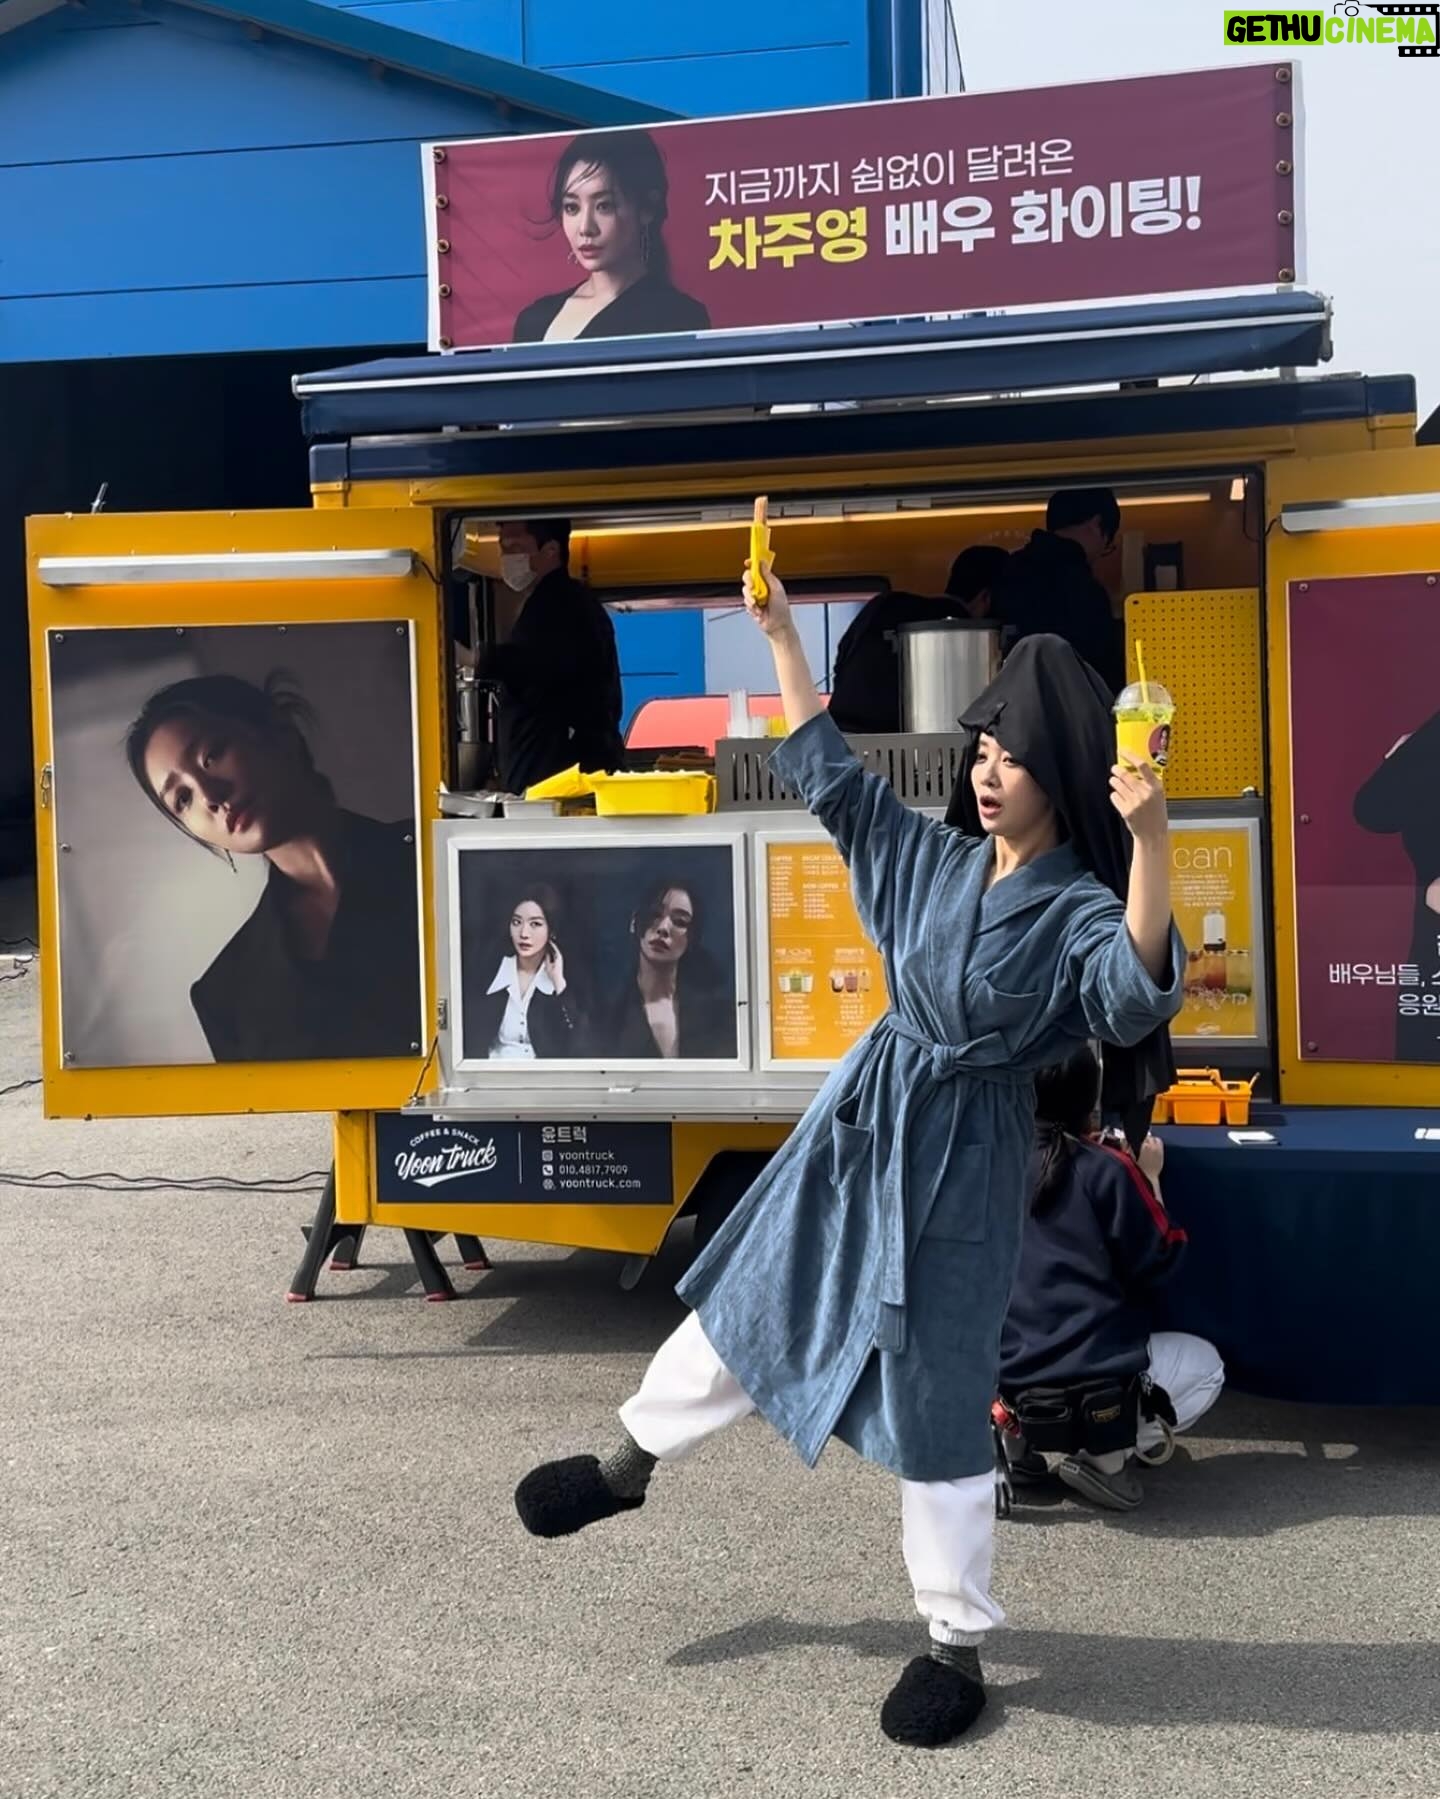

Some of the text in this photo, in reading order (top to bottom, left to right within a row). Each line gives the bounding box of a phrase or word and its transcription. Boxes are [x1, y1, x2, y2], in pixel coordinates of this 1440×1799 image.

[705, 138, 1075, 206] 지금까지 쉼없이 달려온
[708, 175, 1202, 270] 차주영 배우 화이팅!
[1328, 963, 1426, 987] 배우님들,
[409, 1128, 441, 1148] COFFEE
[451, 1128, 481, 1146] SNACK
[541, 1126, 587, 1144] 윤트럭
[394, 1151, 444, 1180] Yoon
[559, 1150, 615, 1161] yoontruck
[559, 1178, 641, 1189] yoontruck.com
